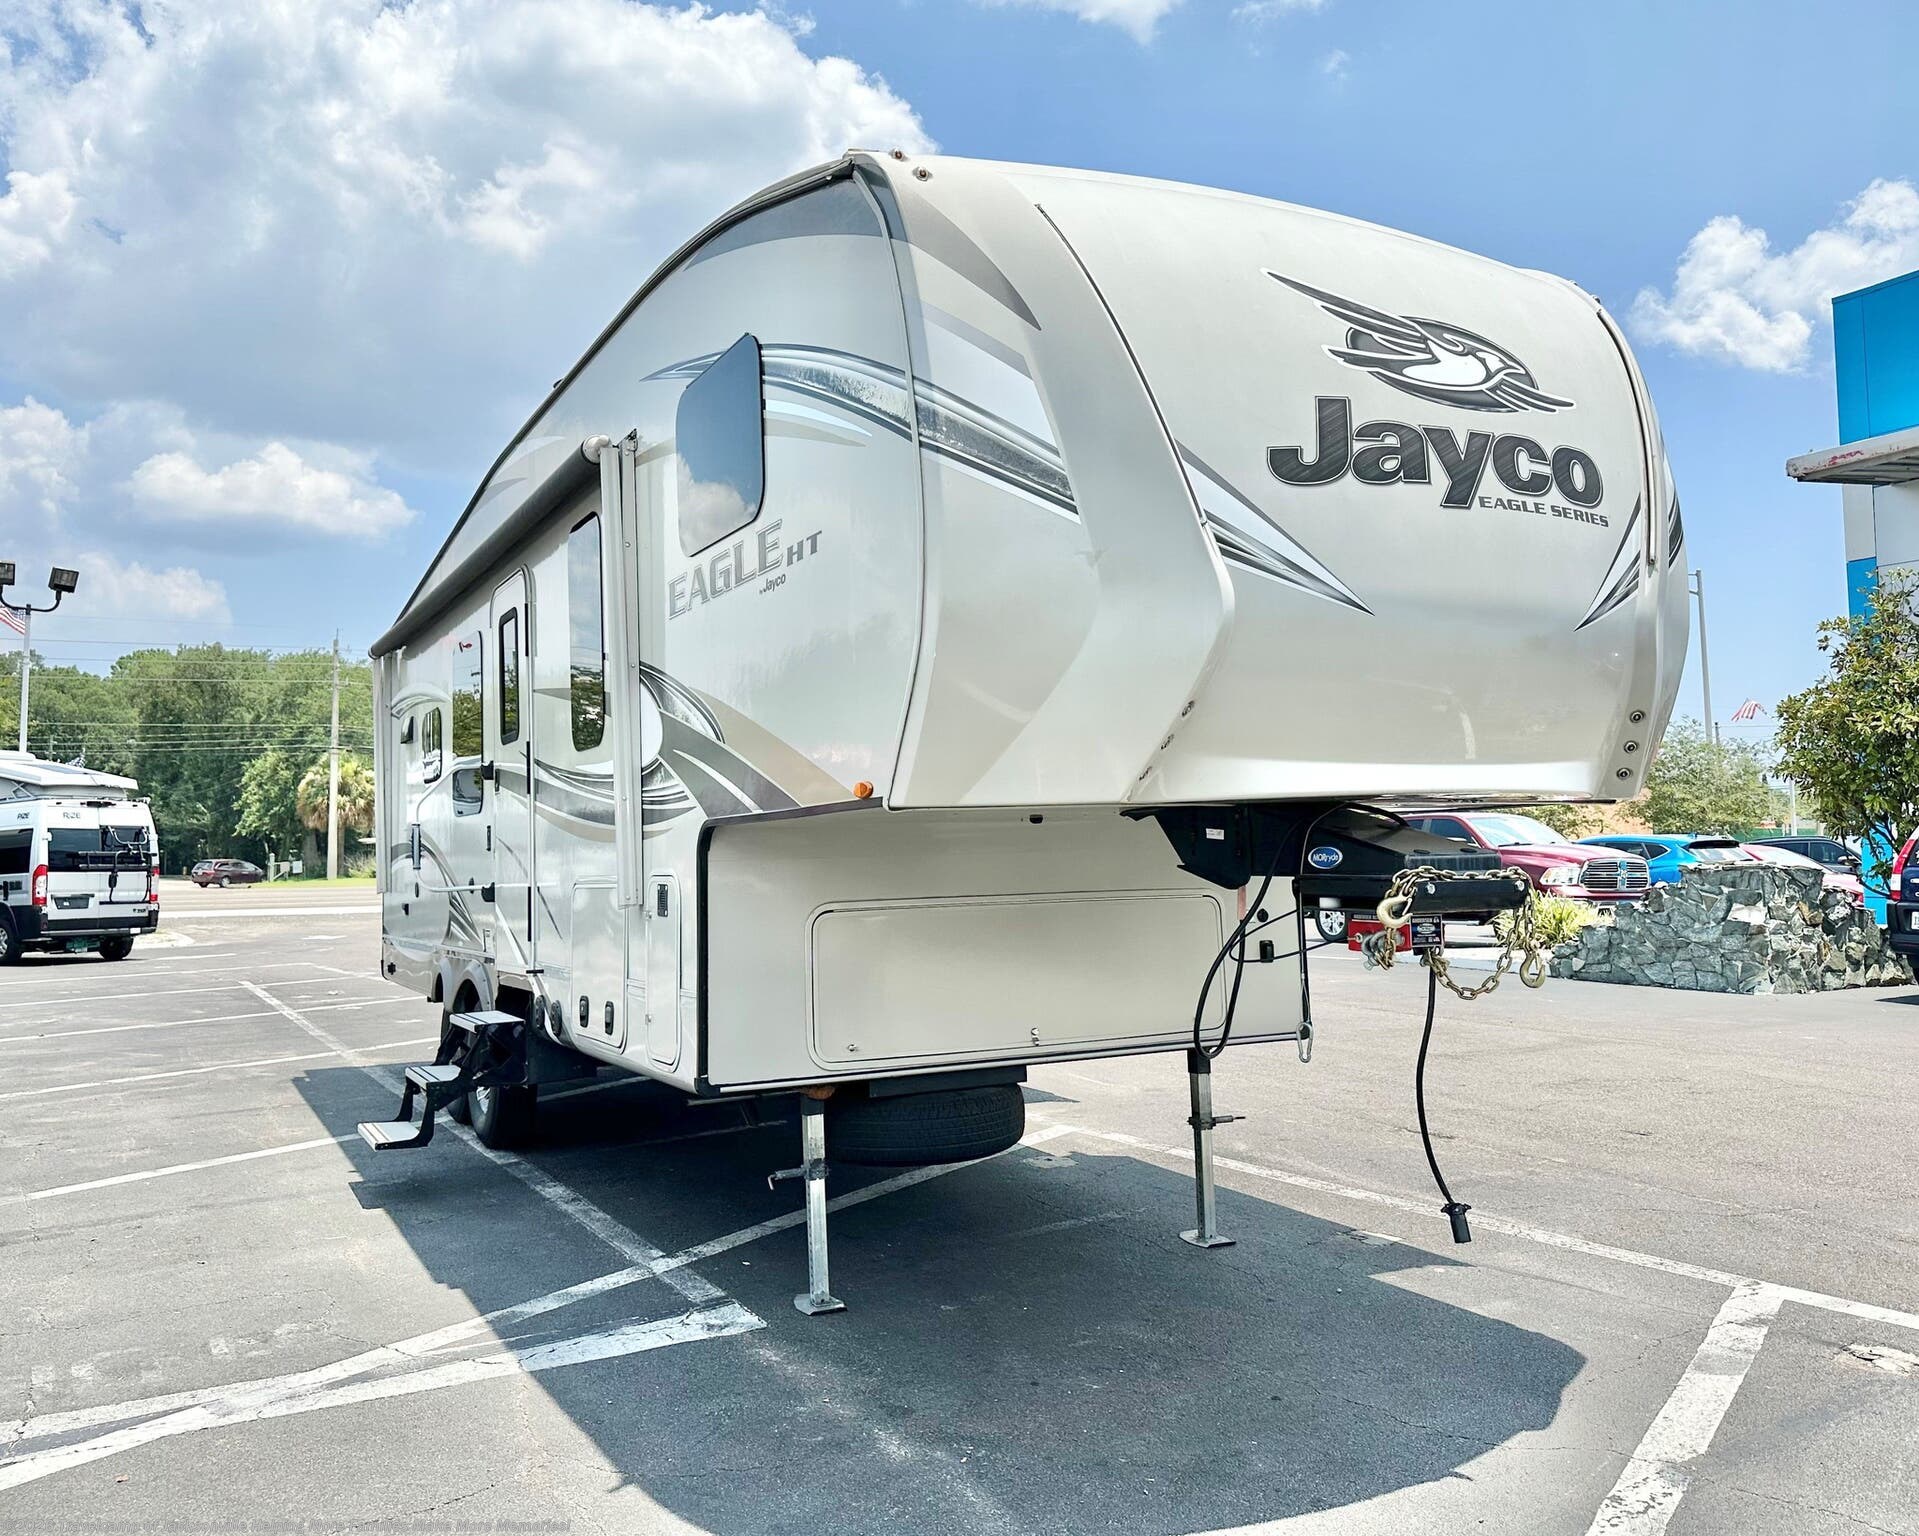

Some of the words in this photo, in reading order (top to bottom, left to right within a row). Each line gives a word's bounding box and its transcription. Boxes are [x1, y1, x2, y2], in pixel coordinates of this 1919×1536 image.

[1266, 395, 1604, 510] Jayco
[1479, 495, 1547, 516] EAGLE
[1551, 505, 1610, 528] SERIES
[667, 518, 784, 621] EAGLE
[786, 530, 823, 568] HT
